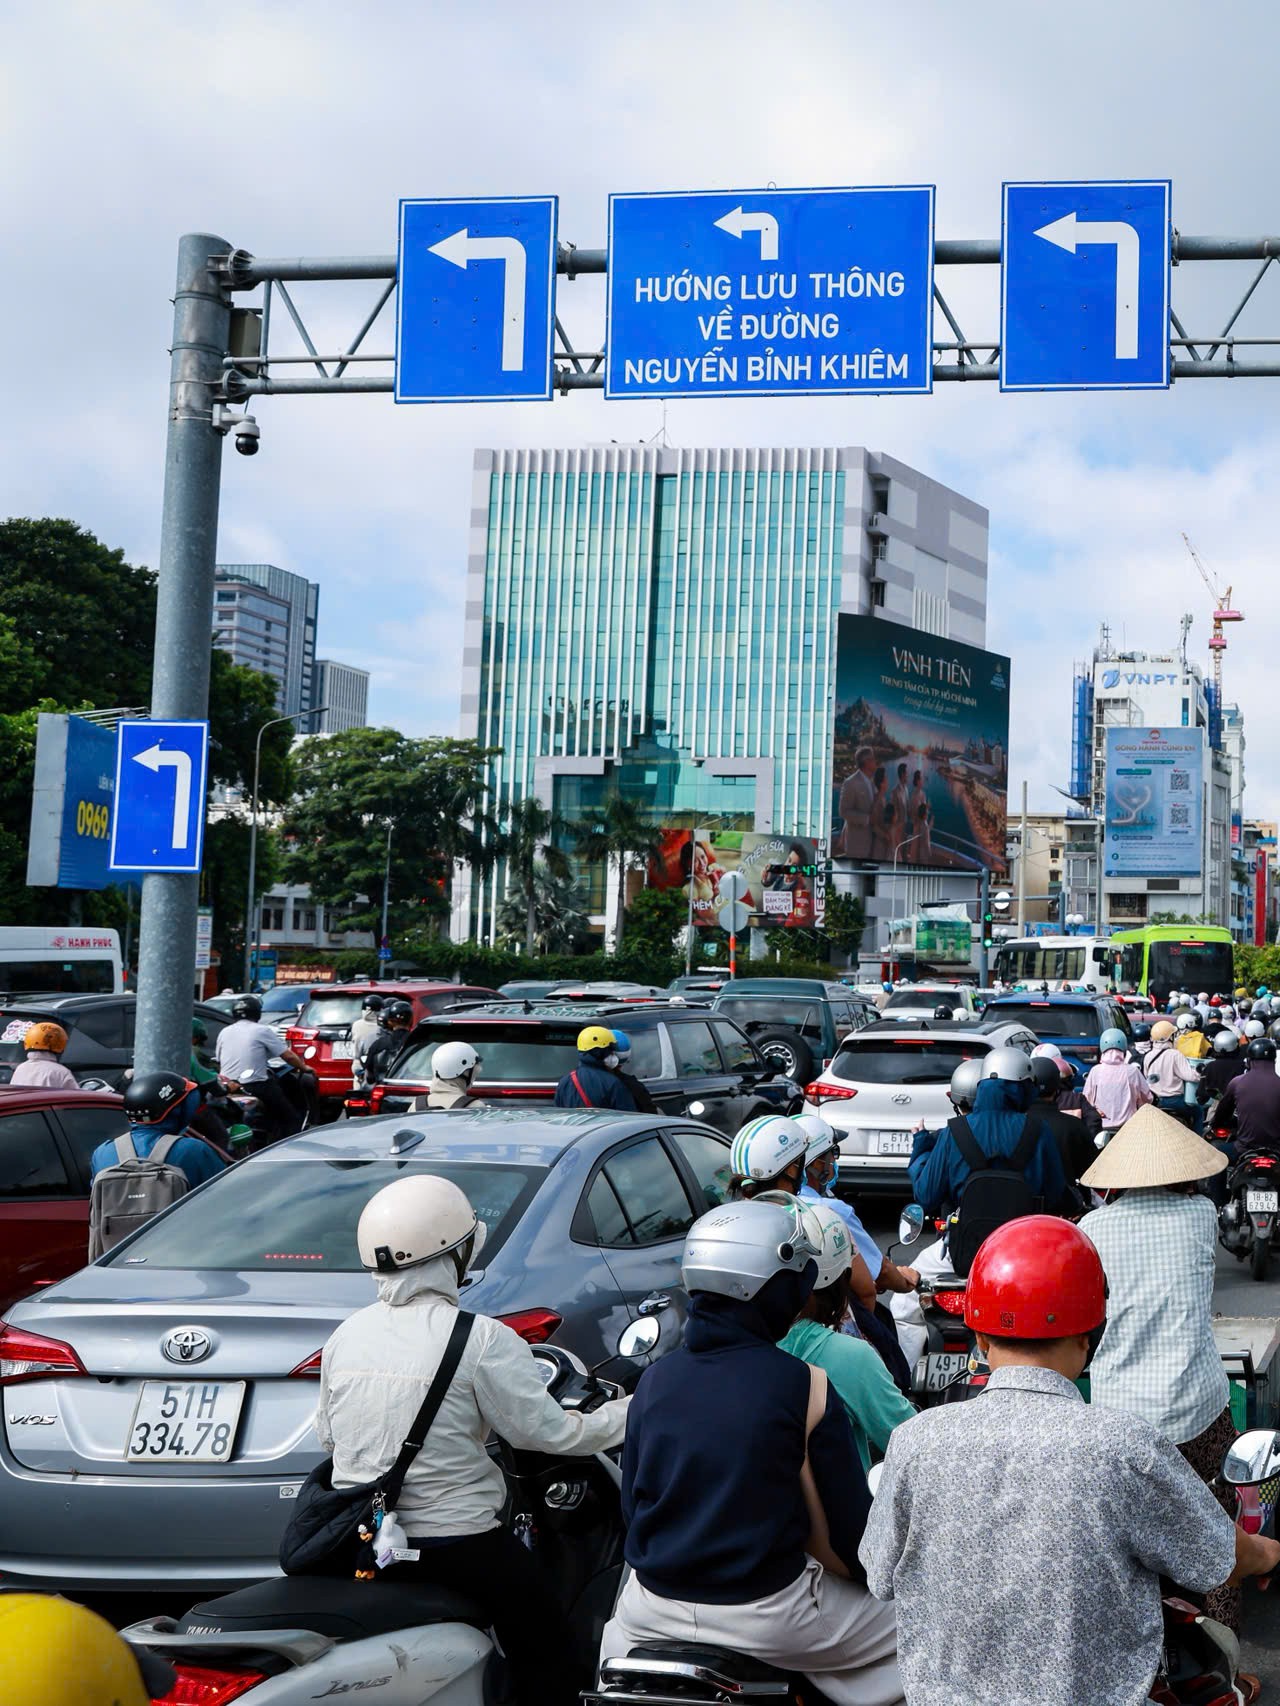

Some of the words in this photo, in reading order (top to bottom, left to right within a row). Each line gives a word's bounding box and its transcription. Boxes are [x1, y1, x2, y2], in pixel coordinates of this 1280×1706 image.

[635, 271, 731, 302] HƯỚNG
[740, 272, 797, 301] LƯU
[809, 265, 905, 299] THÔNG
[698, 304, 733, 340] VỀ
[740, 309, 839, 340] ĐƯỜNG
[624, 348, 740, 384] NGUYỄN
[747, 346, 812, 382] BỈNH
[820, 345, 909, 379] KHIÊM
[892, 646, 932, 678] VỊNH
[935, 658, 972, 689] TIÊN
[1123, 672, 1178, 685] VNPT
[883, 1143, 914, 1152] 511.1
[891, 1133, 909, 1142] 61A
[161, 1385, 219, 1419] 51H
[9, 1413, 58, 1426] VIOS
[131, 1422, 232, 1457] 334.78
